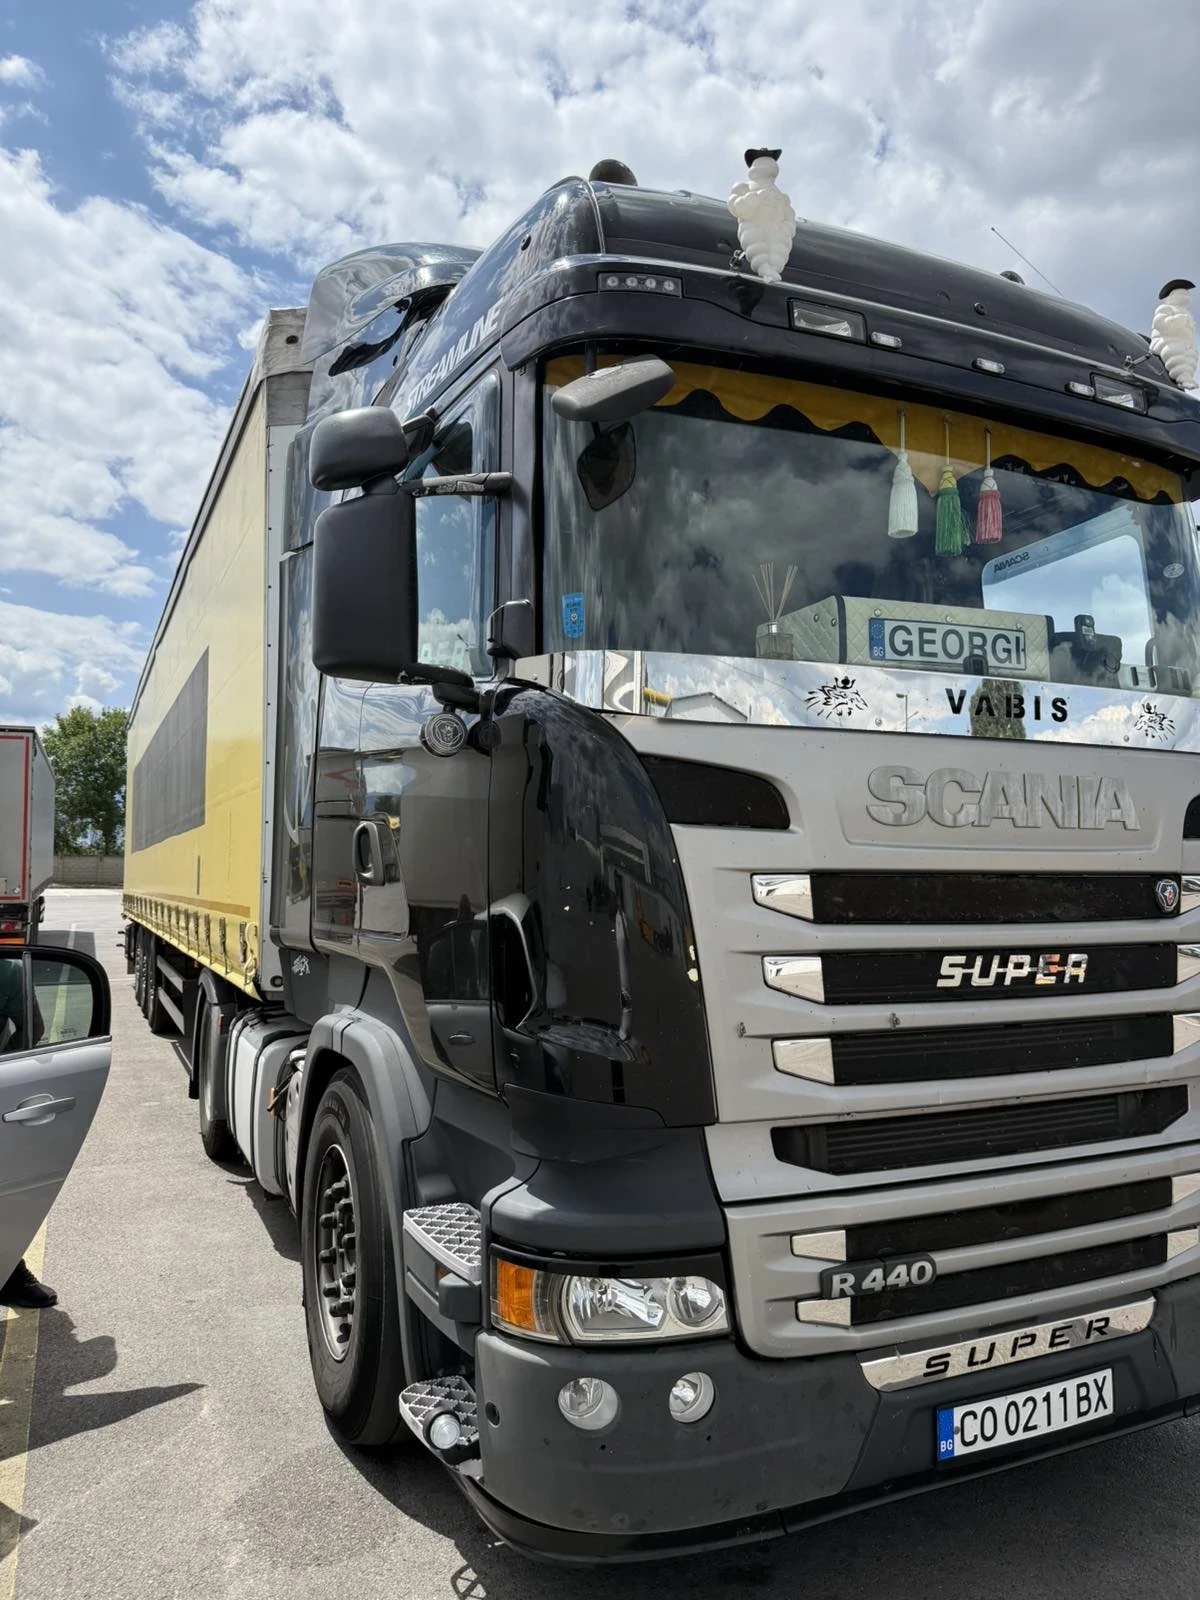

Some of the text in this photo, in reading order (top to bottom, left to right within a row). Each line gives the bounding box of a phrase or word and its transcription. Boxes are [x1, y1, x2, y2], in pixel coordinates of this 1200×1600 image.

[407, 297, 503, 411] STREAMLINE
[888, 625, 1023, 664] GEORGI
[945, 688, 1069, 723] VABIS
[866, 765, 1141, 831] SCANIA
[936, 953, 1089, 988] SUPER
[831, 1260, 934, 1298] R 440
[922, 1316, 1111, 1378] SUPER
[940, 1439, 954, 1452] BG
